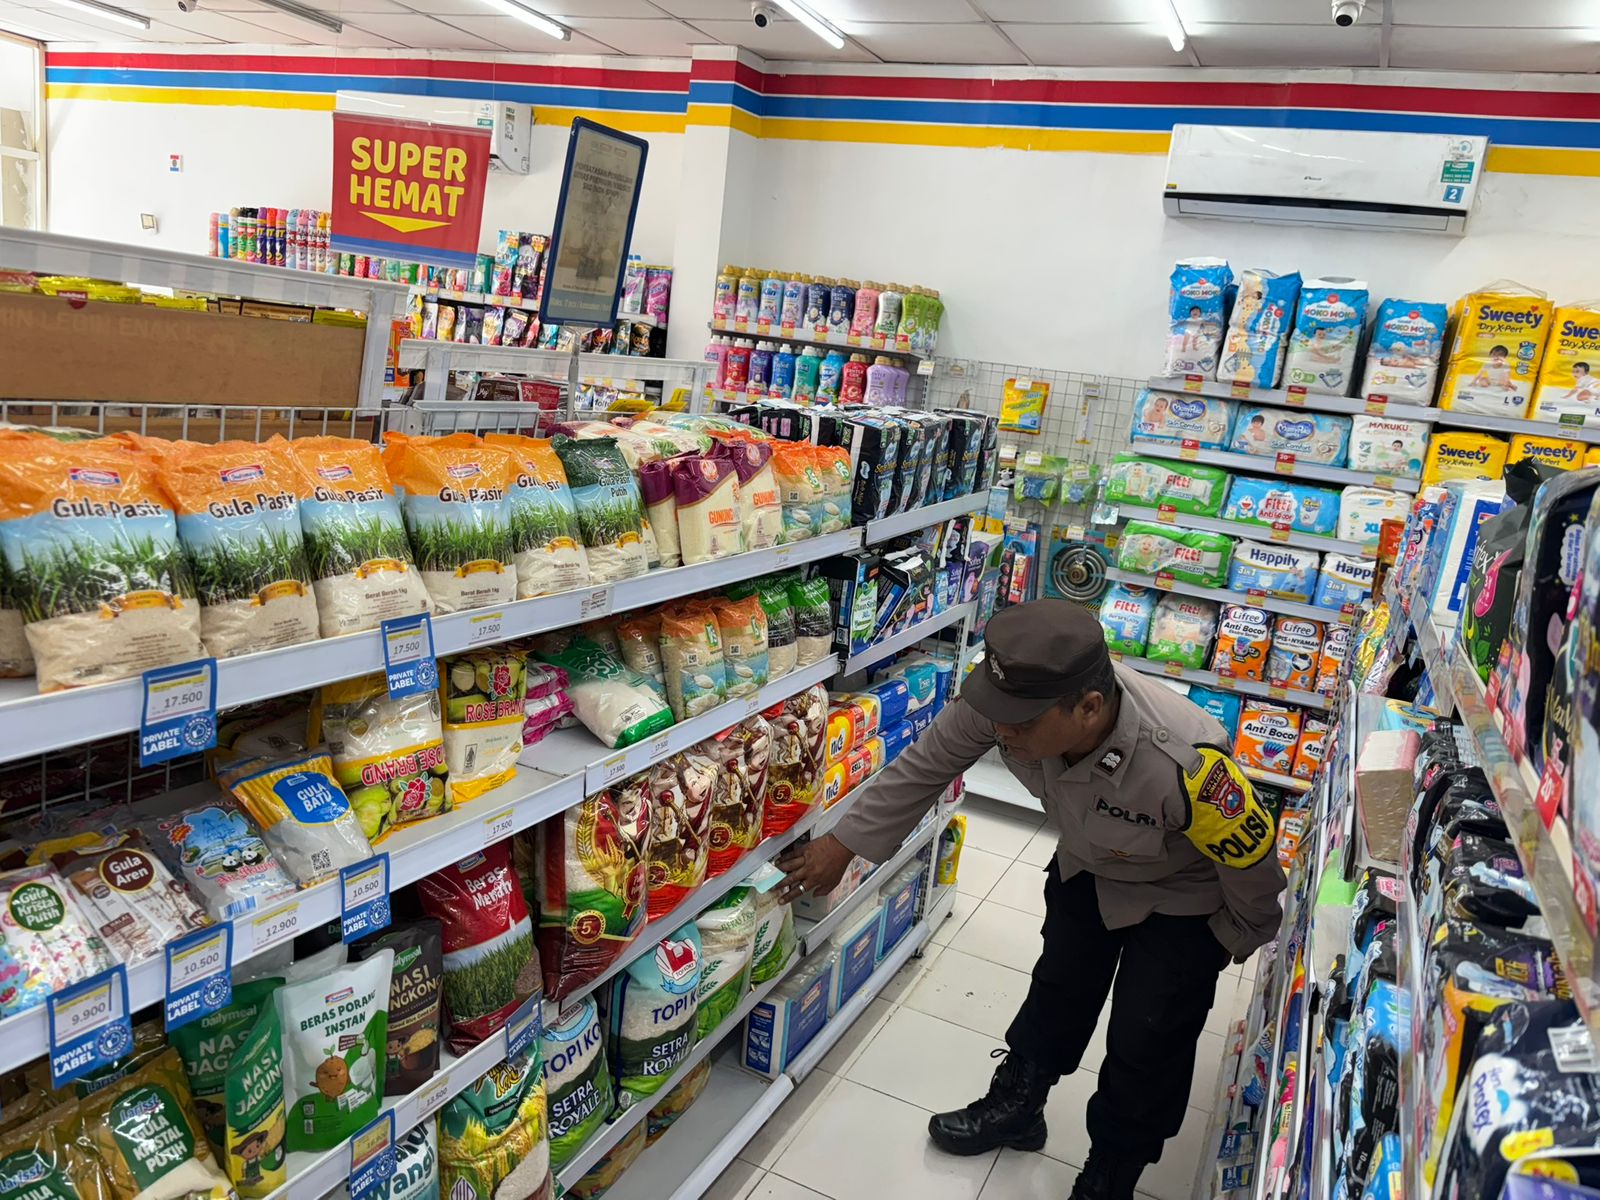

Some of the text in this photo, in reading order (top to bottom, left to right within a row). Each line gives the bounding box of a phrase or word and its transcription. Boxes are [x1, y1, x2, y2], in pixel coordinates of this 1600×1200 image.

[351, 136, 468, 182] SUPER
[349, 173, 465, 217] HEMAT
[1449, 189, 1458, 200] 2
[1478, 305, 1544, 330] Sweety
[1480, 323, 1494, 334] Dry
[1561, 338, 1578, 349] Dry
[1504, 396, 1510, 406] L
[1438, 443, 1491, 464] Sweety
[1522, 441, 1578, 460] Sweety
[598, 474, 615, 487] Gula
[1166, 475, 1192, 488] Fitti
[314, 486, 384, 504] Gula Pasir
[439, 485, 467, 504] Gula
[610, 486, 628, 498] Putih
[53, 497, 162, 519] Gula Pasir
[208, 490, 296, 519] Gula Pasir
[1265, 498, 1292, 512] Fitti
[1173, 547, 1203, 562] Fitti
[1250, 548, 1300, 569] Happily
[1335, 561, 1376, 580] Happi
[1114, 599, 1139, 614] Fitti
[1178, 603, 1201, 615] Fitti
[1233, 610, 1260, 623] Lifree
[478, 623, 501, 636] 17.500
[1224, 621, 1266, 636] Anti Bocor
[1284, 623, 1312, 636] Lifree
[393, 641, 420, 655] 17.500
[388, 669, 414, 682] PRIVATE
[389, 677, 415, 691] LABEL
[163, 690, 203, 710] 17.500
[465, 702, 496, 723] ROSE
[1261, 713, 1285, 727] Lifree
[142, 727, 181, 746] PRIVATE
[1244, 722, 1299, 741] Anti Bocor
[143, 737, 181, 756] LABEL
[361, 745, 445, 787] OSE BRAND
[609, 763, 626, 777] 17.500
[297, 783, 327, 801] GULA
[776, 788, 785, 800] 5
[303, 792, 332, 814] BATU
[1096, 798, 1157, 827] POLRI
[492, 819, 513, 834] 17.500
[1206, 808, 1269, 863] POLISI
[713, 831, 722, 843] 5
[108, 856, 142, 876] Gula
[115, 868, 150, 887] Aren
[465, 868, 503, 893] Beras
[18, 887, 49, 906] Gula
[352, 879, 379, 899] 10.500
[16, 896, 58, 918] Kristal
[26, 907, 61, 927] Putih
[265, 916, 297, 938] 12.900
[343, 911, 368, 928] PRIVATE
[344, 919, 368, 937] LABEL
[582, 920, 592, 934] 5
[183, 952, 220, 976] 10.500
[390, 964, 430, 997] NASI
[167, 990, 201, 1011] PRIVATE
[72, 1002, 106, 1025] 9.900
[167, 1001, 201, 1022] LABEL
[300, 1010, 337, 1033] BERAS
[652, 998, 688, 1026] TOPI
[324, 1011, 367, 1038] INSTAN
[53, 1040, 95, 1066] PRIVATE
[651, 1032, 689, 1058] SETRA
[54, 1053, 96, 1078] LABEL
[187, 1051, 233, 1076] JAG
[242, 1047, 278, 1091] NASI
[120, 1093, 162, 1122] Larisst
[552, 1079, 594, 1118] SETRA
[548, 1087, 602, 1140] ROYALE
[134, 1115, 170, 1139] GULA
[145, 1140, 188, 1174] PUTIH
[351, 1169, 375, 1189] PRIVATE
[351, 1177, 375, 1197] LABEL
